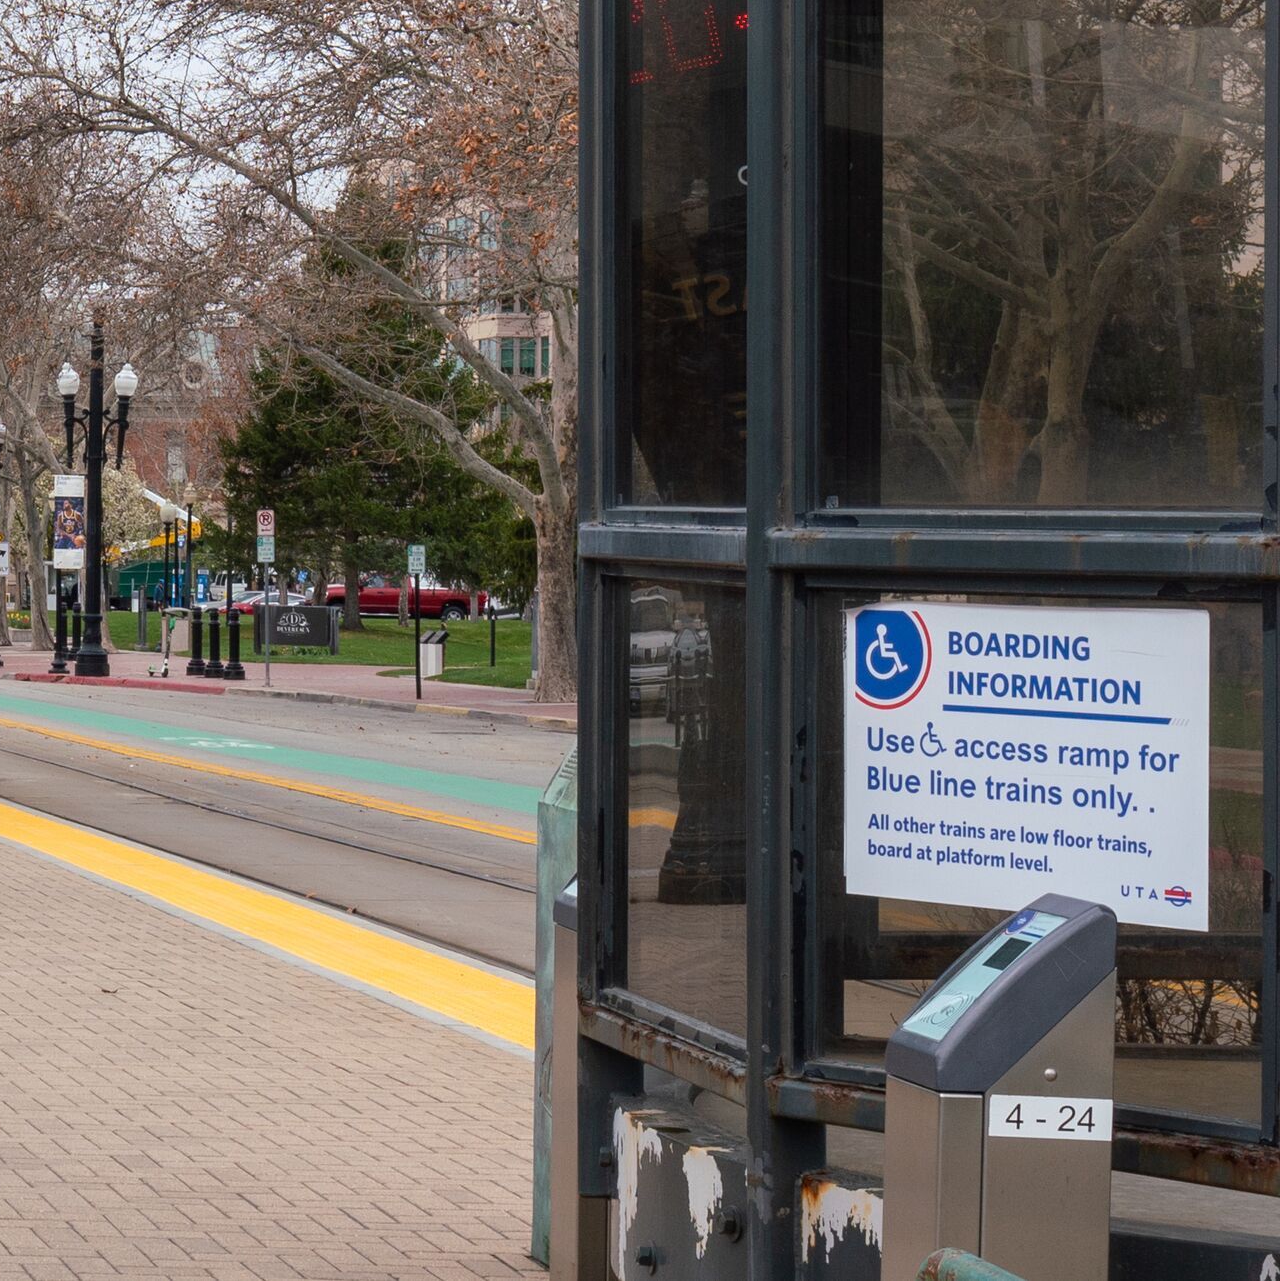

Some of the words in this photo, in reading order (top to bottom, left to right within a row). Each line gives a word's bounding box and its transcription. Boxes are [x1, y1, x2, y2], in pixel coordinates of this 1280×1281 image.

[948, 631, 1091, 661] BOARDING
[948, 671, 1141, 705] INFORMATION
[867, 726, 915, 754] Use
[954, 737, 1048, 765] access
[1058, 744, 1129, 775] ramp
[1139, 745, 1180, 773] for
[867, 766, 920, 794] Blue
[930, 770, 976, 798] line
[986, 776, 1062, 805] trains
[868, 813, 889, 831] All
[893, 816, 934, 836] other
[940, 820, 985, 840] trains
[990, 828, 1016, 843] are
[1020, 826, 1049, 846] low
[1053, 829, 1093, 849] floor
[1098, 834, 1153, 858] trains,
[868, 840, 912, 860] board
[916, 846, 932, 862] at
[936, 846, 1006, 870] platform
[1010, 852, 1053, 873] level.
[1121, 884, 1158, 901] UTA
[1005, 1103, 1024, 1130] 4
[1057, 1105, 1095, 1133] 24
